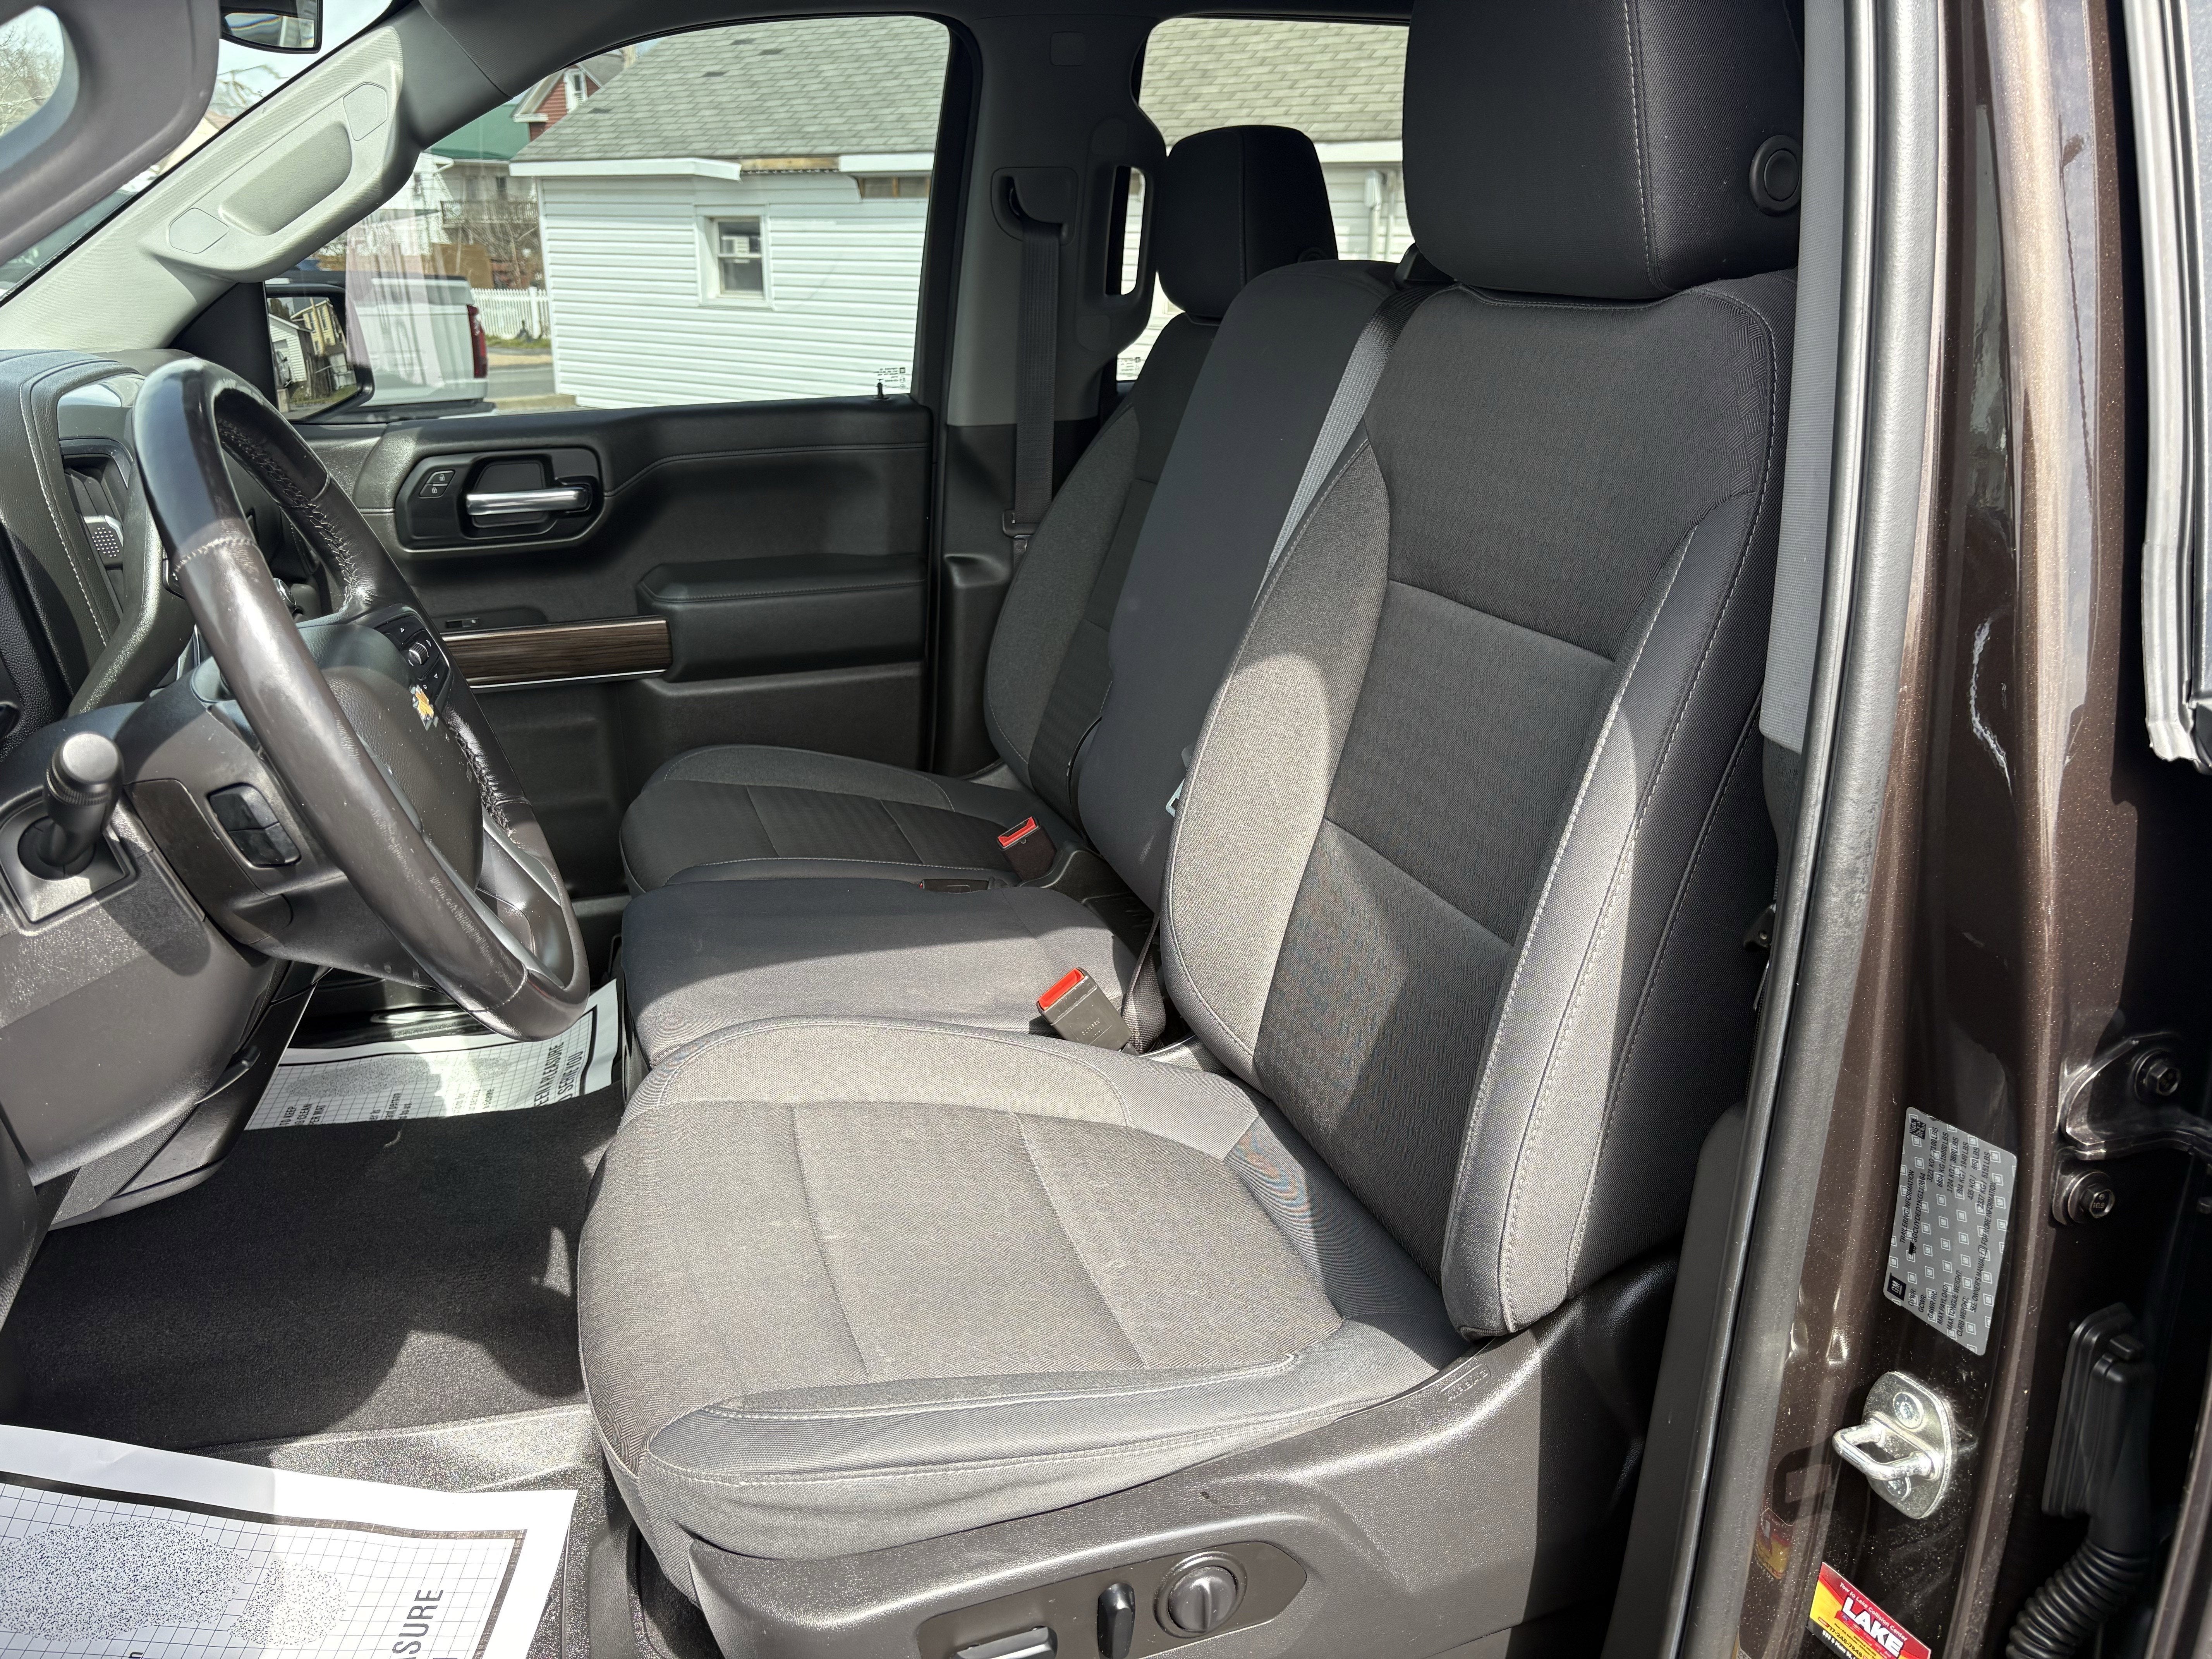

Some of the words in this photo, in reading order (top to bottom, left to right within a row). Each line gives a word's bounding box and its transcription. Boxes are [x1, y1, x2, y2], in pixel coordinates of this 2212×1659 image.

[541, 1042, 564, 1084] PLEASURE
[565, 1051, 584, 1071] YOU
[558, 1067, 579, 1095] SERVE
[283, 1106, 297, 1118] KEEP
[297, 1104, 313, 1120] CLEAN
[1929, 1158, 1934, 1168] KG
[1939, 1163, 1945, 1173] KG
[1949, 1168, 1954, 1178] KG
[1959, 1173, 1965, 1183] KG
[1969, 1179, 1975, 1188] KG
[1980, 1184, 1986, 1194] KG
[1899, 1209, 1909, 1243] TRAILERING
[1905, 1170, 1914, 1209] INFORMATION
[1976, 1257, 1985, 1277] MANUAL
[1986, 1182, 1996, 1217] INFORMATION
[1891, 1280, 1899, 1293] GM
[1953, 1269, 1961, 1293] WEIGHT:
[1949, 1293, 1958, 1316] TONGUE
[1840, 1582, 1850, 1592] Tow
[1856, 1597, 1868, 1608] Lake
[1869, 1607, 1889, 1626] Collision
[1890, 1625, 1907, 1641] Center
[392, 1589, 444, 1659] SURE
[1843, 1597, 1904, 1657] LAKE
